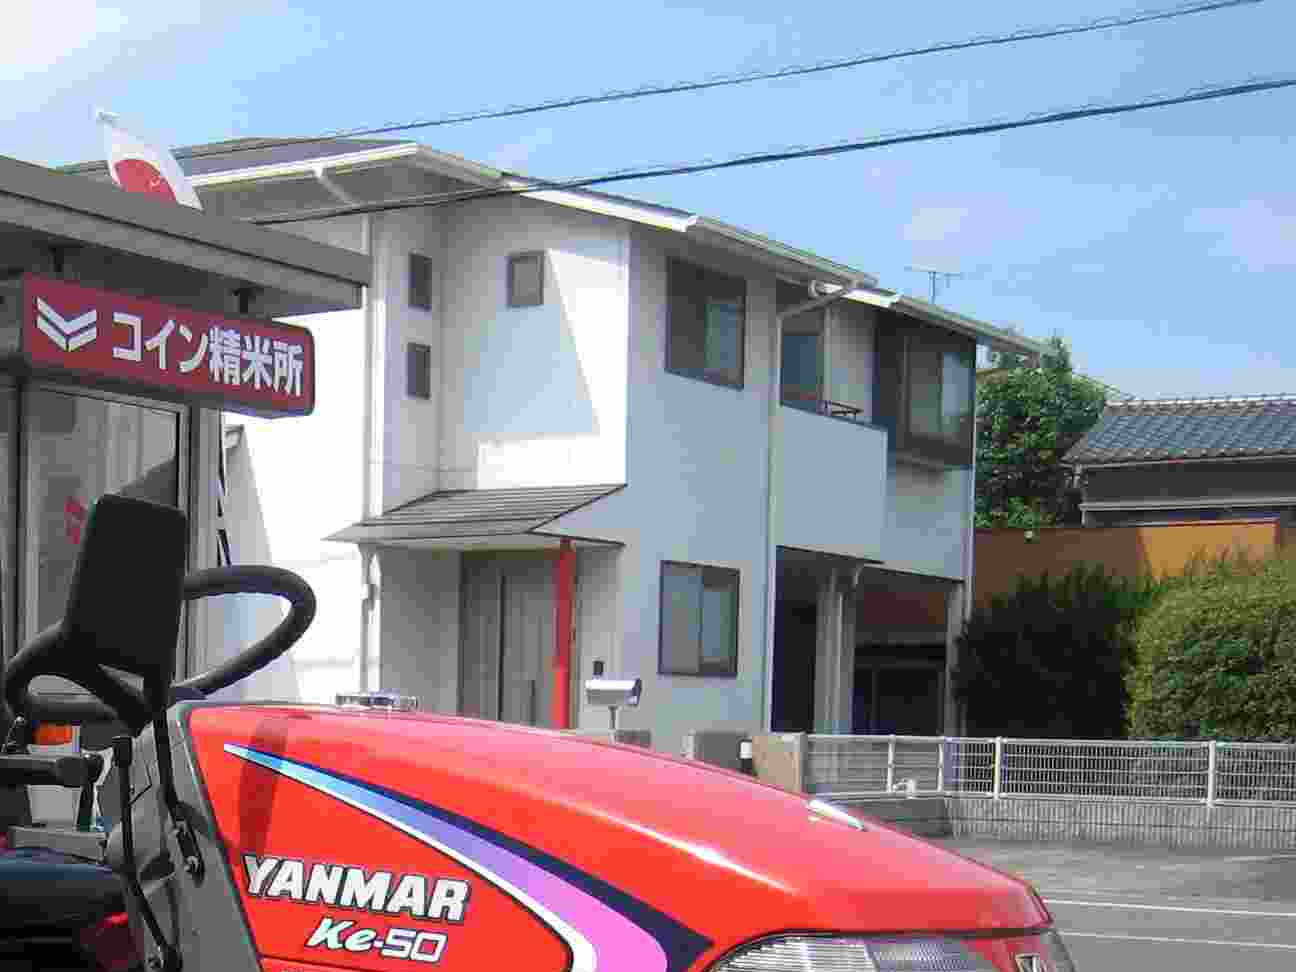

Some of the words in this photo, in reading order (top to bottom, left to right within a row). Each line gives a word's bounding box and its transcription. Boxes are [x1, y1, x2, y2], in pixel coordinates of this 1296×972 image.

[112, 311, 305, 398] コイン精米所
[243, 854, 470, 922] YANMAR
[306, 916, 449, 963] Ke-50
